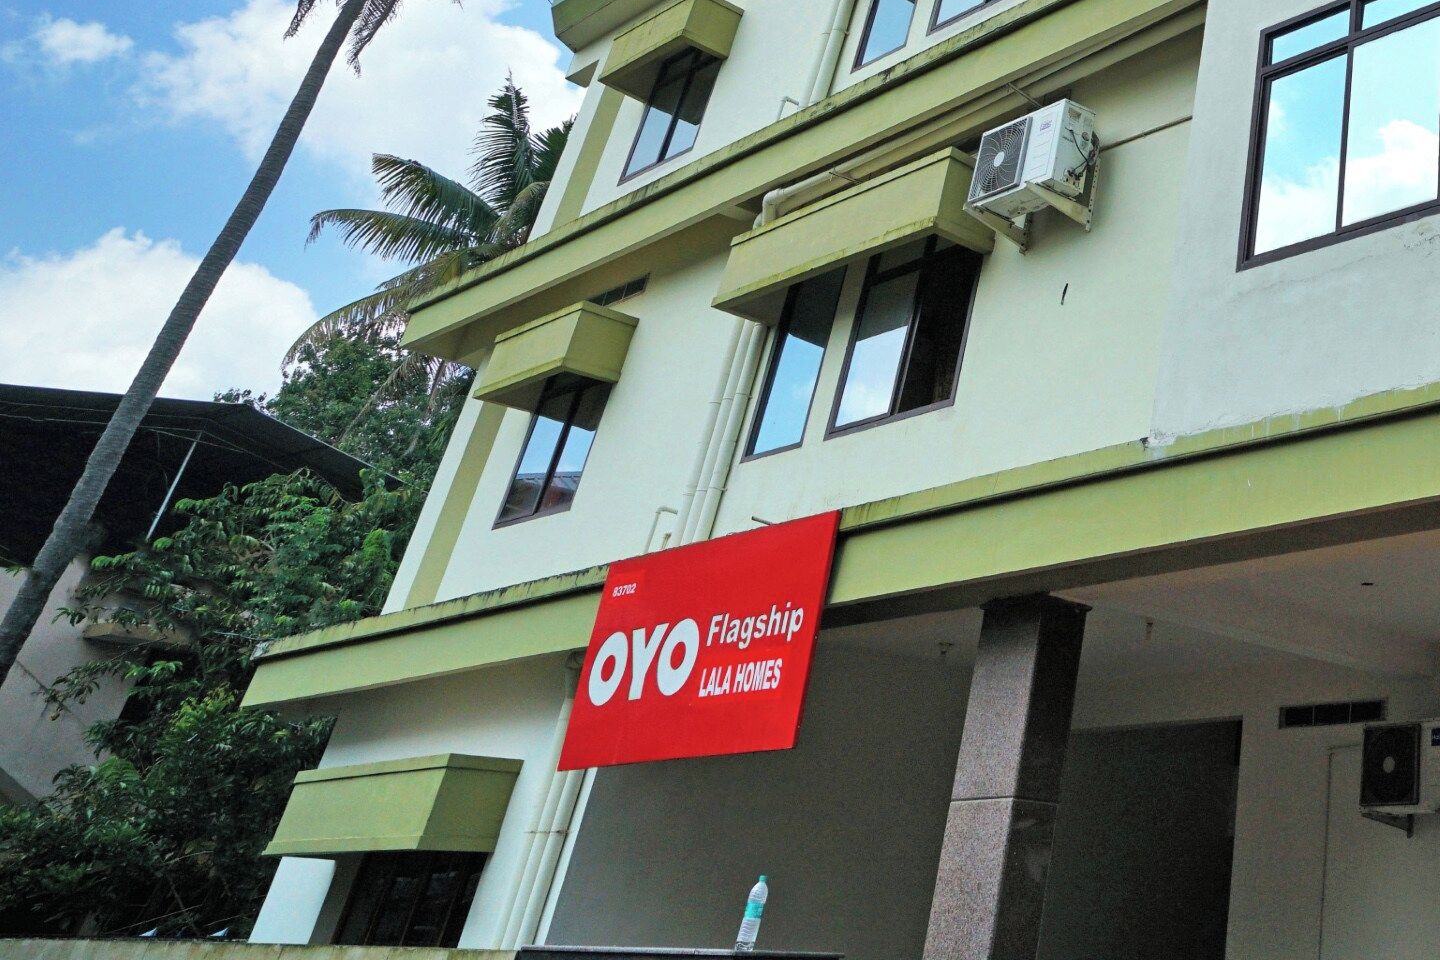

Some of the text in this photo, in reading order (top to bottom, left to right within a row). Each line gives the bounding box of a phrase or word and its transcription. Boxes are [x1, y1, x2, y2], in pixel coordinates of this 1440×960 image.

[706, 601, 804, 649] Flagship
[588, 617, 700, 707] OYO
[698, 657, 783, 698] LALA HOMES
